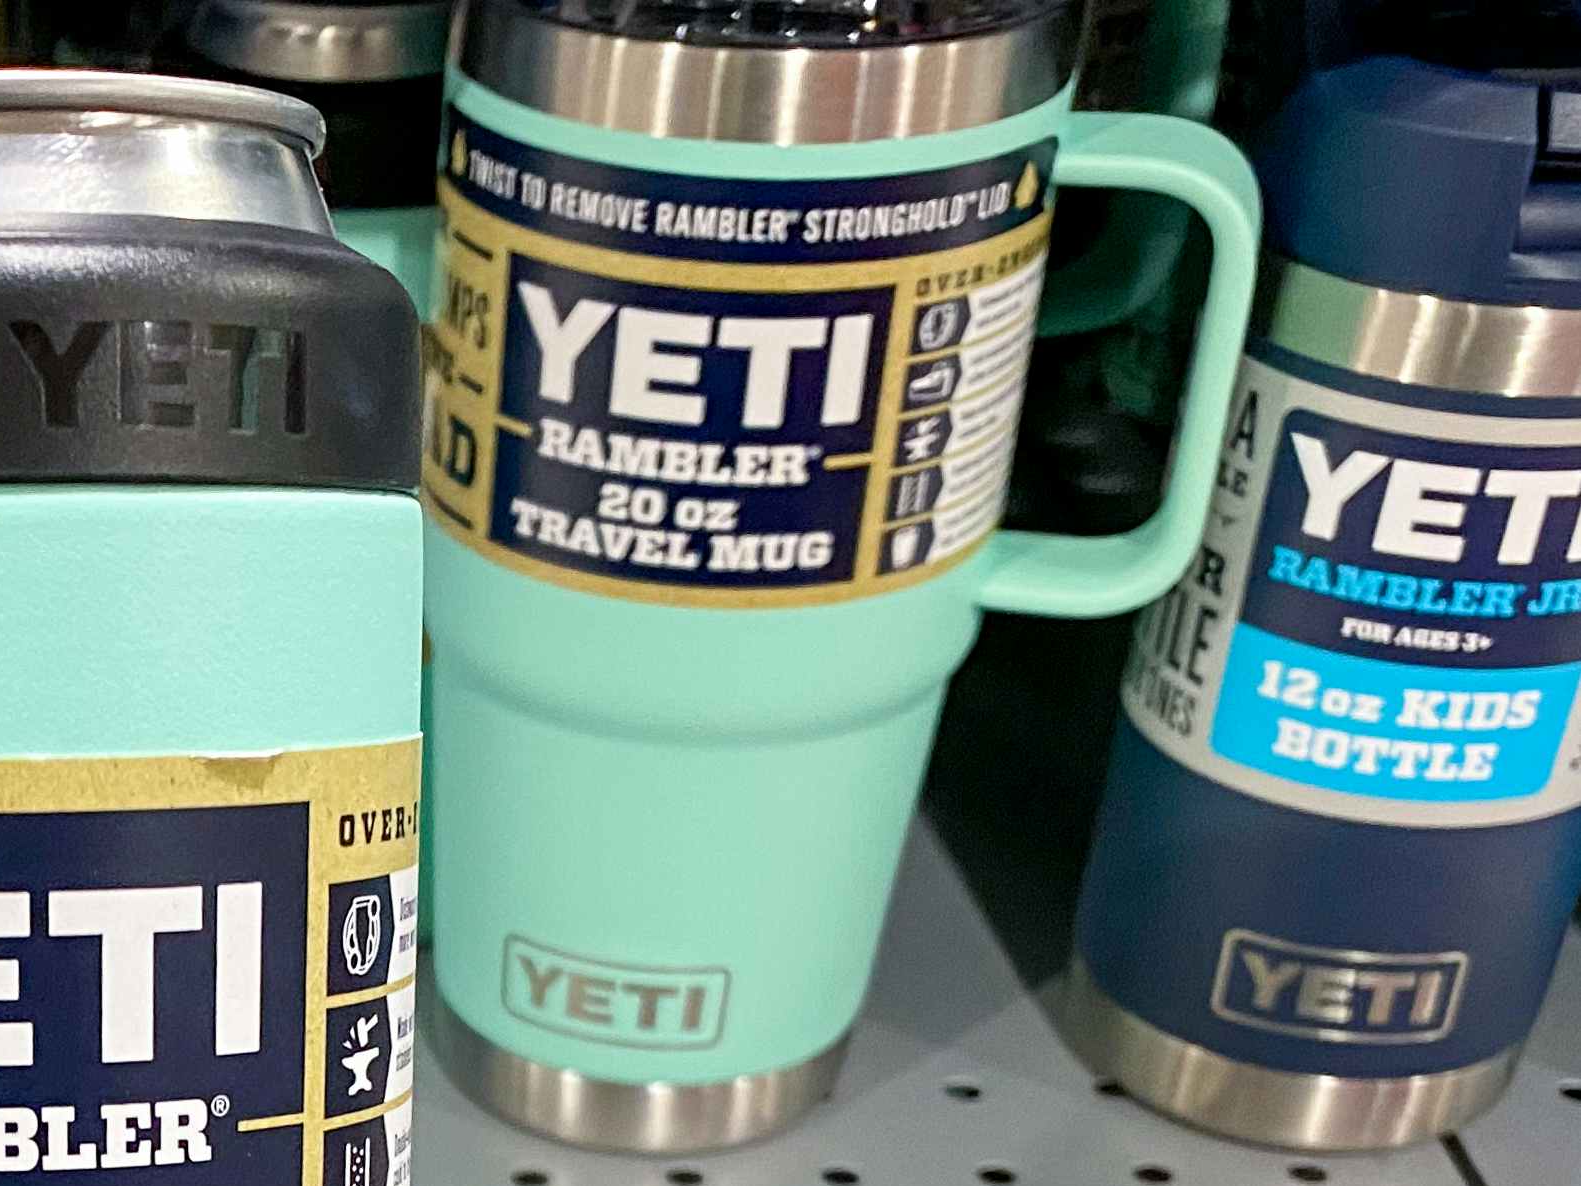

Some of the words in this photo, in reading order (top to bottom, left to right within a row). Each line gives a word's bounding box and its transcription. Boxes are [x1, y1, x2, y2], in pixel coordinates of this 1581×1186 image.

[469, 149, 518, 199] TWIST
[521, 171, 547, 211] TO
[550, 182, 651, 234] REMOVE
[977, 181, 1014, 220] LID
[9, 319, 308, 435] YETI
[520, 281, 874, 430] YETI
[511, 497, 701, 570] TRAVEL
[707, 530, 835, 572] MUG
[597, 481, 667, 525] 20
[674, 497, 740, 532] oz
[1341, 616, 1393, 646] FOR
[1394, 626, 1461, 652] AGES
[1462, 632, 1494, 653] 3+
[1395, 689, 1542, 730] KIDS
[1271, 716, 1500, 782] BOTTLE
[516, 954, 707, 1032] YETI
[1242, 950, 1448, 1026] YETI
